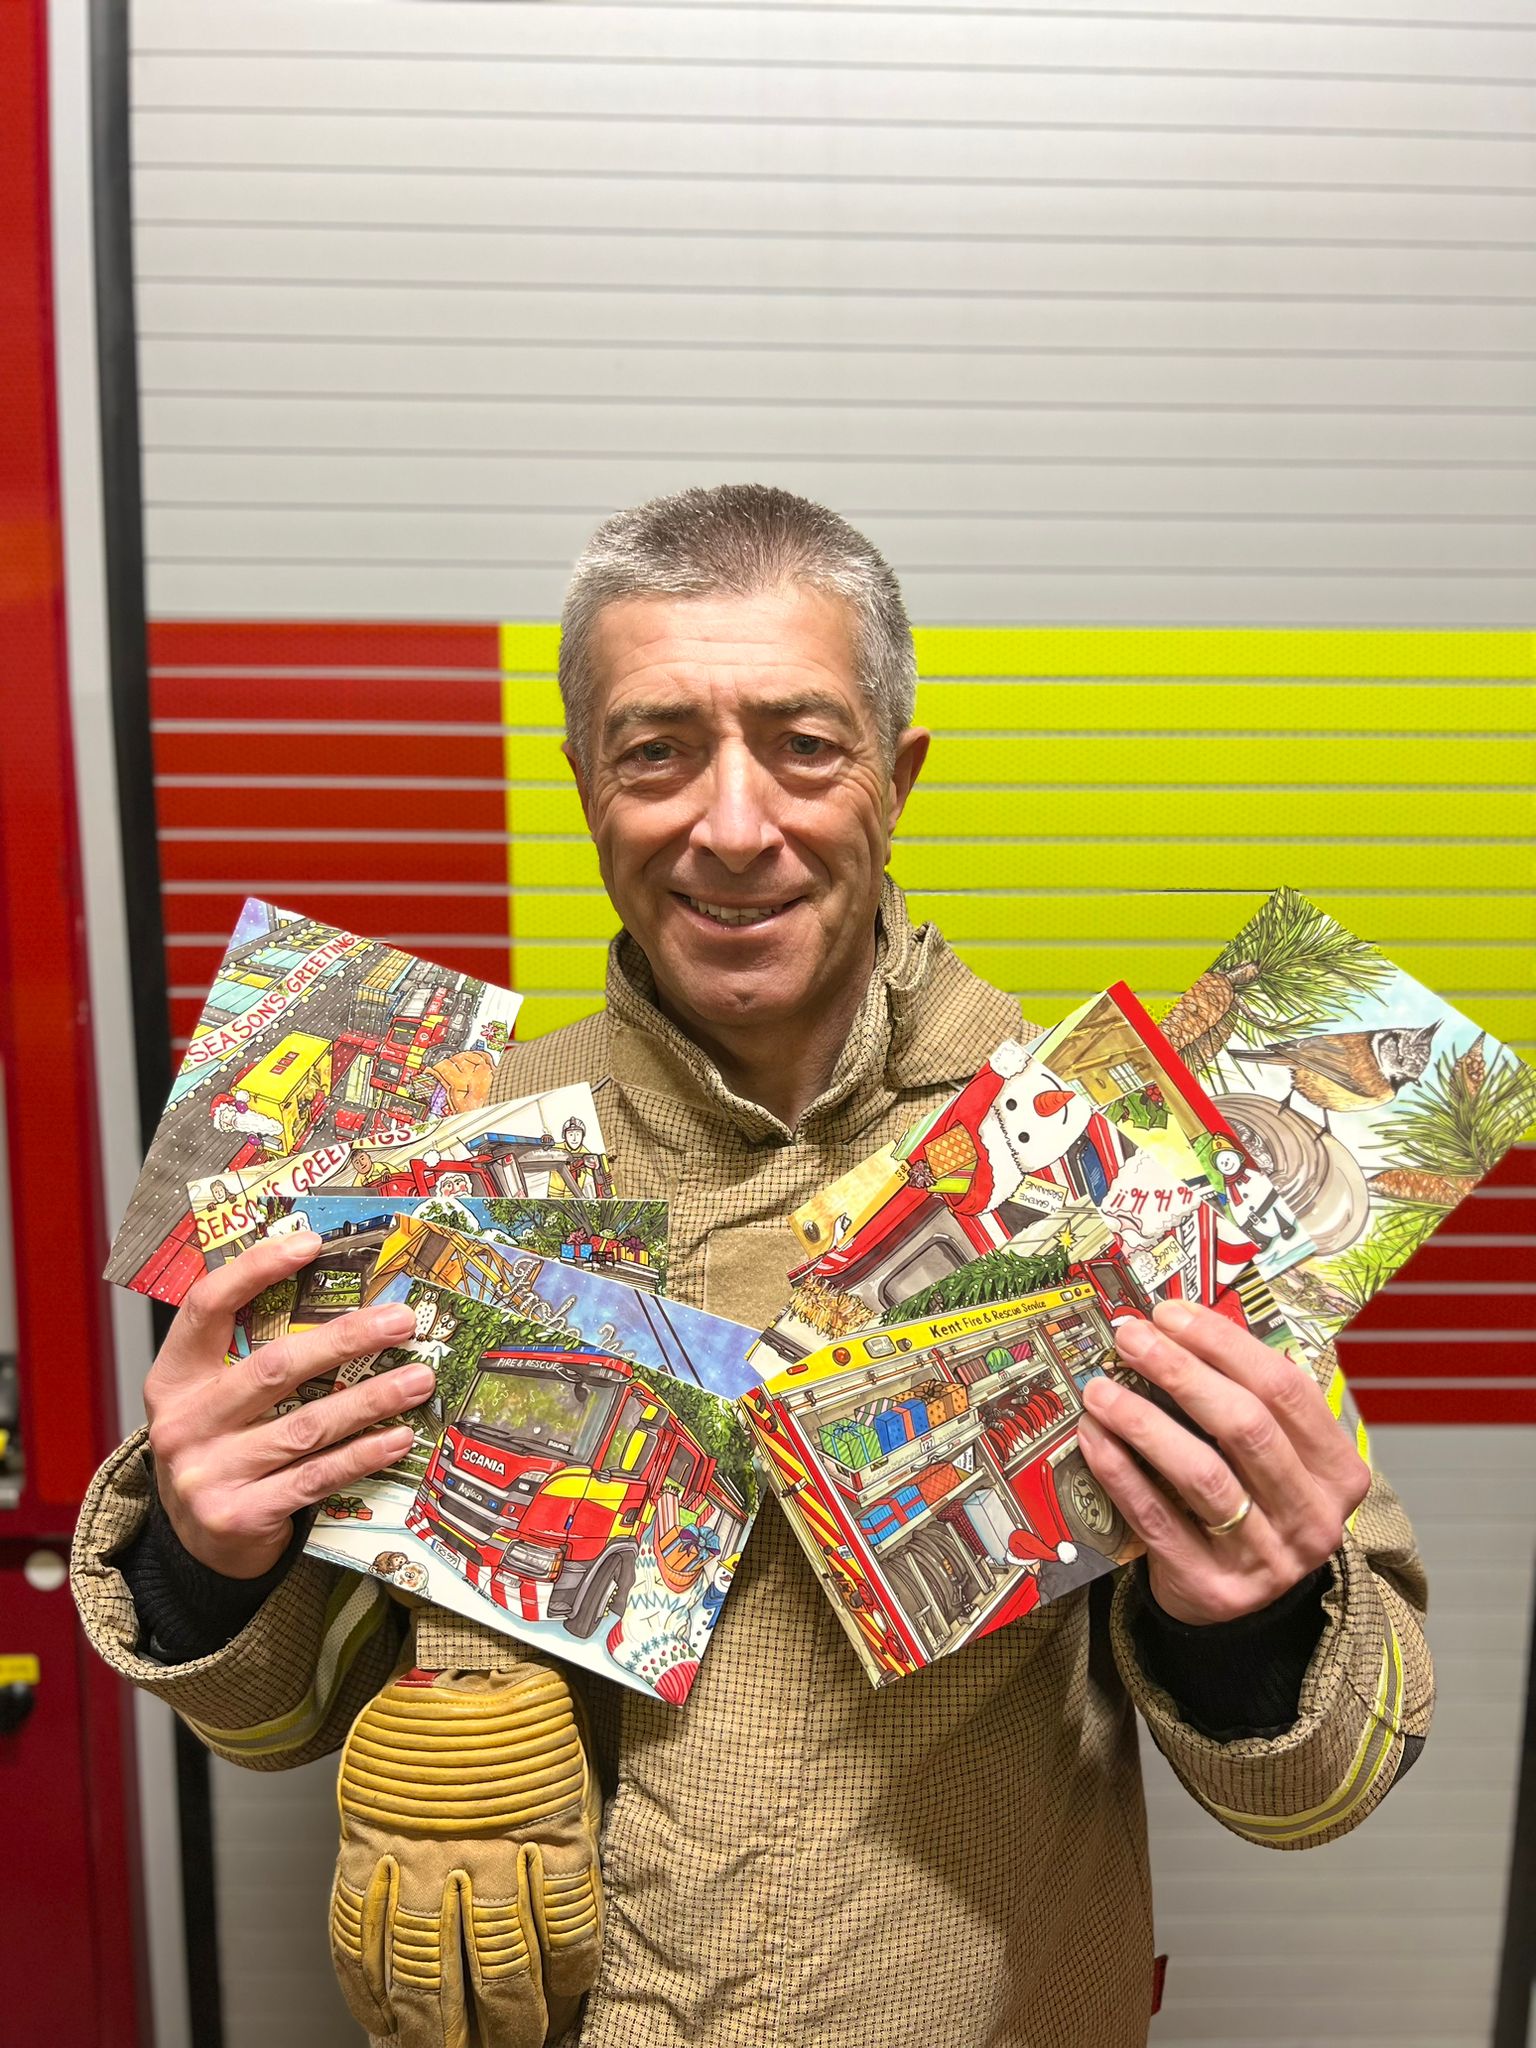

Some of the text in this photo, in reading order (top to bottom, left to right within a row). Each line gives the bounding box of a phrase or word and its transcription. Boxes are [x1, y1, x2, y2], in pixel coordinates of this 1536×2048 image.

[188, 931, 363, 1064] SEASON'S GREETING
[1019, 1192, 1050, 1209] GRAEME
[1025, 1180, 1065, 1202] BROWNING
[1154, 1188, 1173, 1213] Ho
[928, 1300, 1047, 1339] Kent Fire & Rescue Service
[341, 1356, 362, 1379] FEUE
[496, 1357, 562, 1371] FIRE & RESCUE
[461, 1448, 506, 1476] SCANIA
